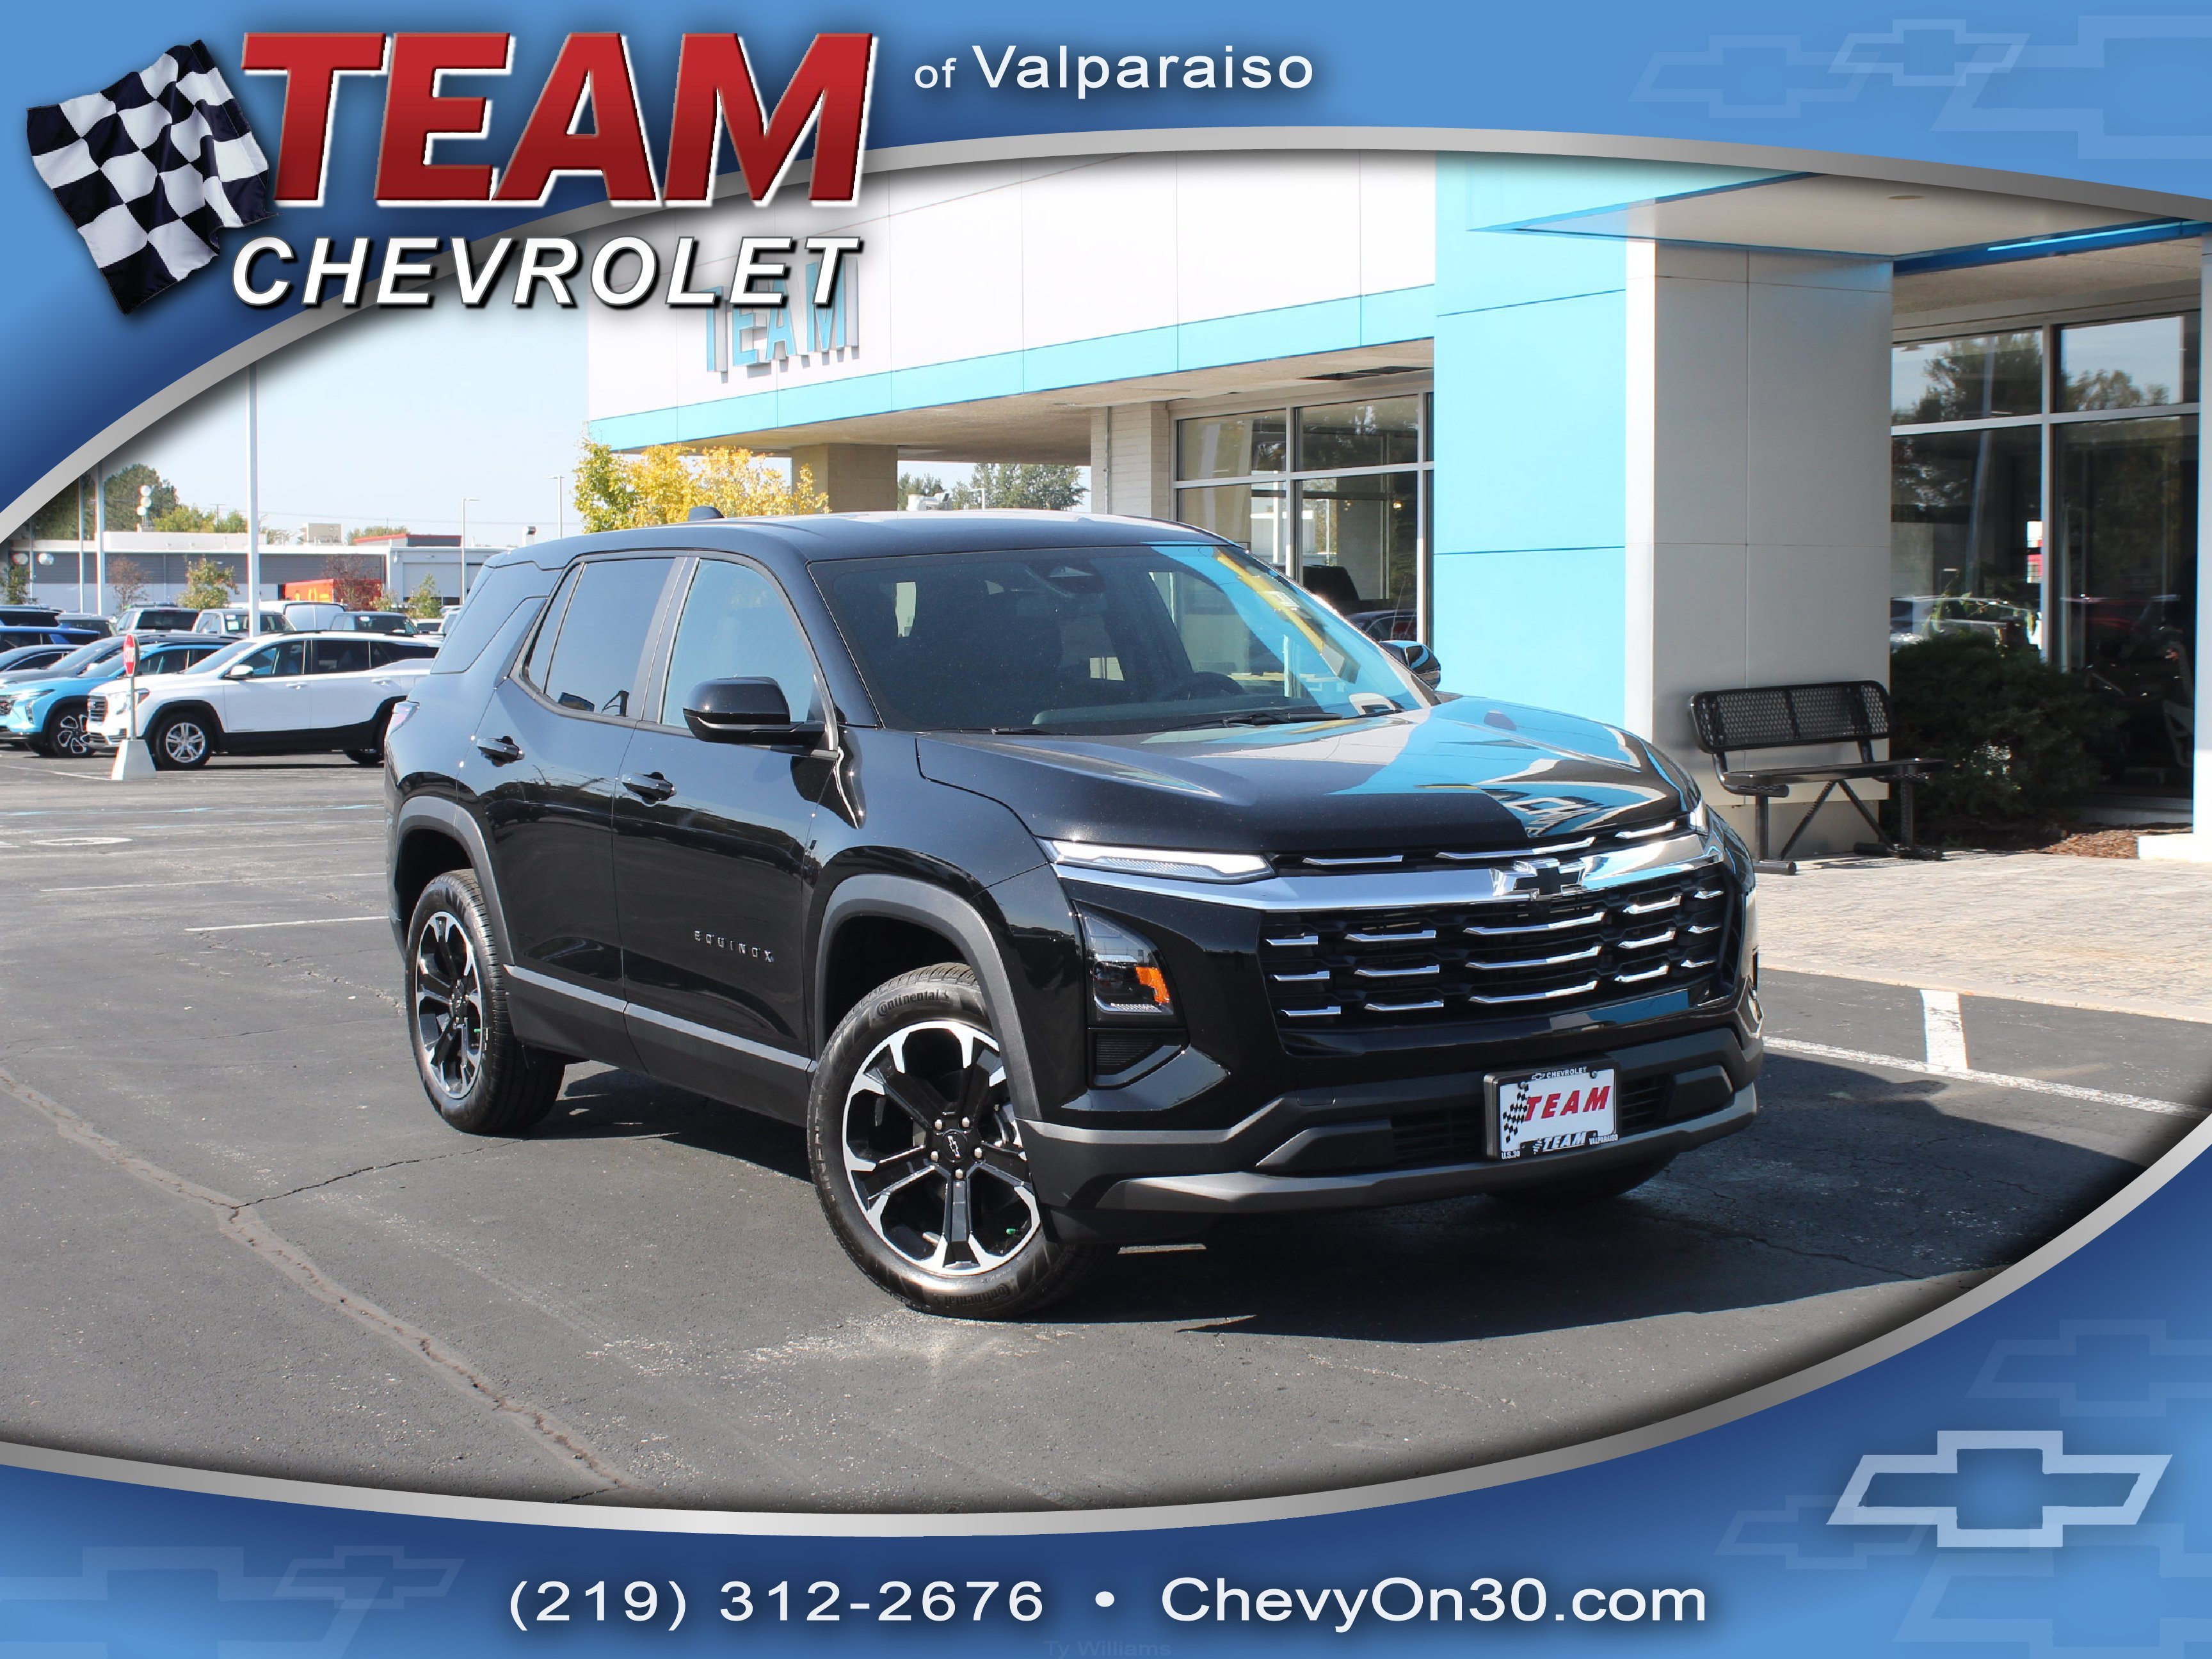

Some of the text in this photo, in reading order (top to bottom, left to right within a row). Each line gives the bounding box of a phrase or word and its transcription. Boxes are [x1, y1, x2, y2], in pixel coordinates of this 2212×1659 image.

[699, 256, 853, 373] TEAM
[694, 930, 774, 963] EQUINOX
[877, 989, 940, 1016] Continental
[1546, 1066, 1587, 1078] CHEVROLET
[1525, 1086, 1611, 1121] TEAM
[1543, 1132, 1587, 1150] TEAM
